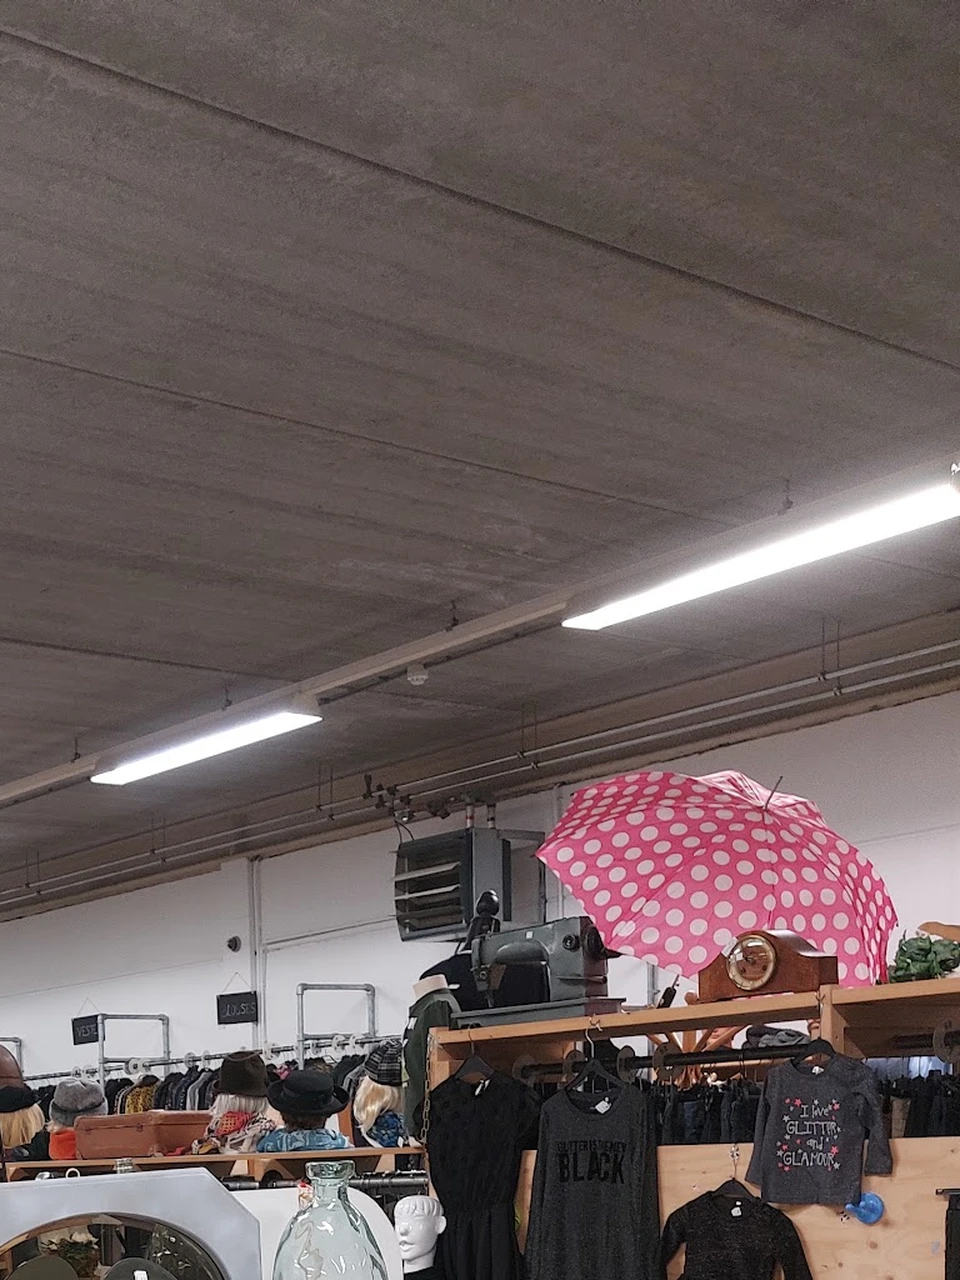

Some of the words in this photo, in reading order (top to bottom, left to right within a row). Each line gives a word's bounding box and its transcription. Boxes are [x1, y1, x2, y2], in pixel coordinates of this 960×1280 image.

[800, 1104, 808, 1118] I
[786, 1120, 837, 1136] GLITTER
[557, 1140, 588, 1153] GLITTER
[806, 1136, 824, 1151] and
[783, 1151, 835, 1167] GLAMOUR
[558, 1152, 625, 1185] BLACK
